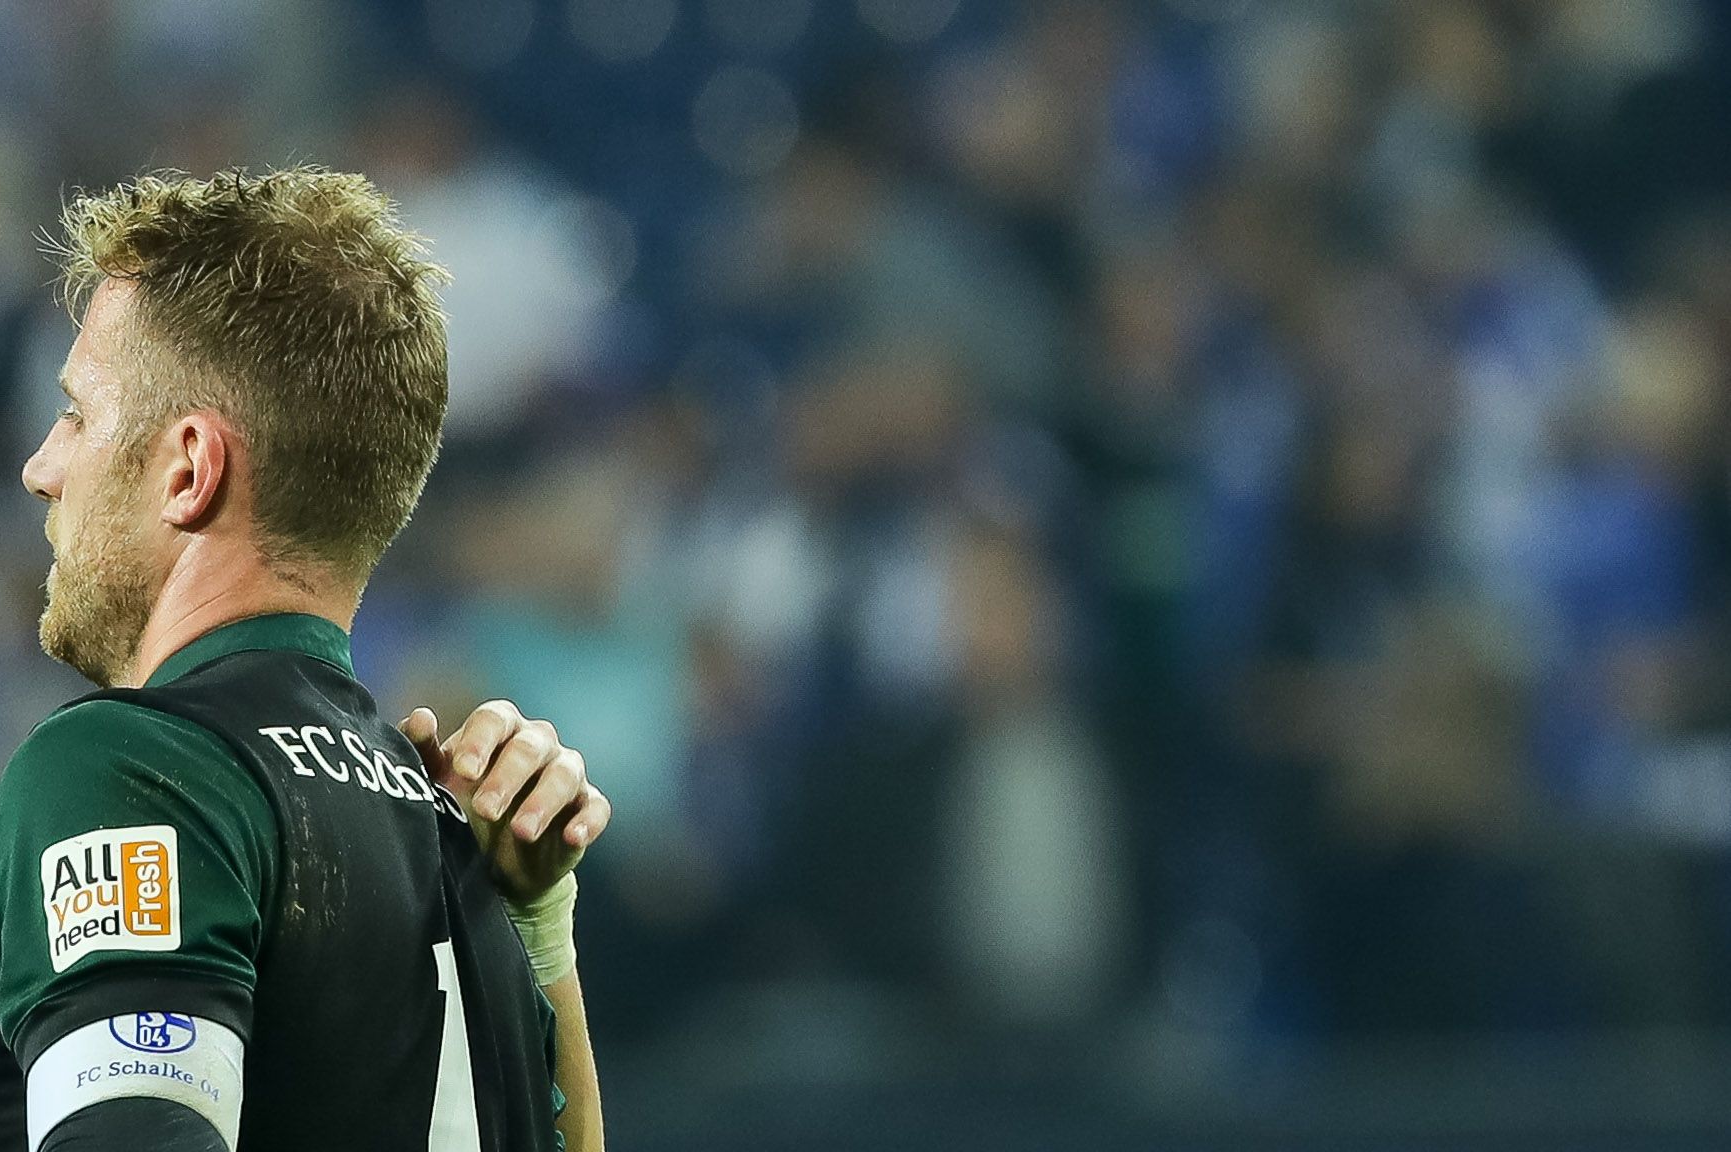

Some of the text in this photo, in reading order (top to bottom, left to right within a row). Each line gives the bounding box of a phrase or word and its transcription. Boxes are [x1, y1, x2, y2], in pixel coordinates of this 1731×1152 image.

[258, 726, 349, 783] FC
[51, 843, 118, 902] All
[129, 843, 163, 932] Fresh
[52, 884, 118, 931] you
[55, 910, 121, 956] need
[139, 1026, 166, 1047] 04
[76, 1060, 220, 1102] FC Schalke 04
